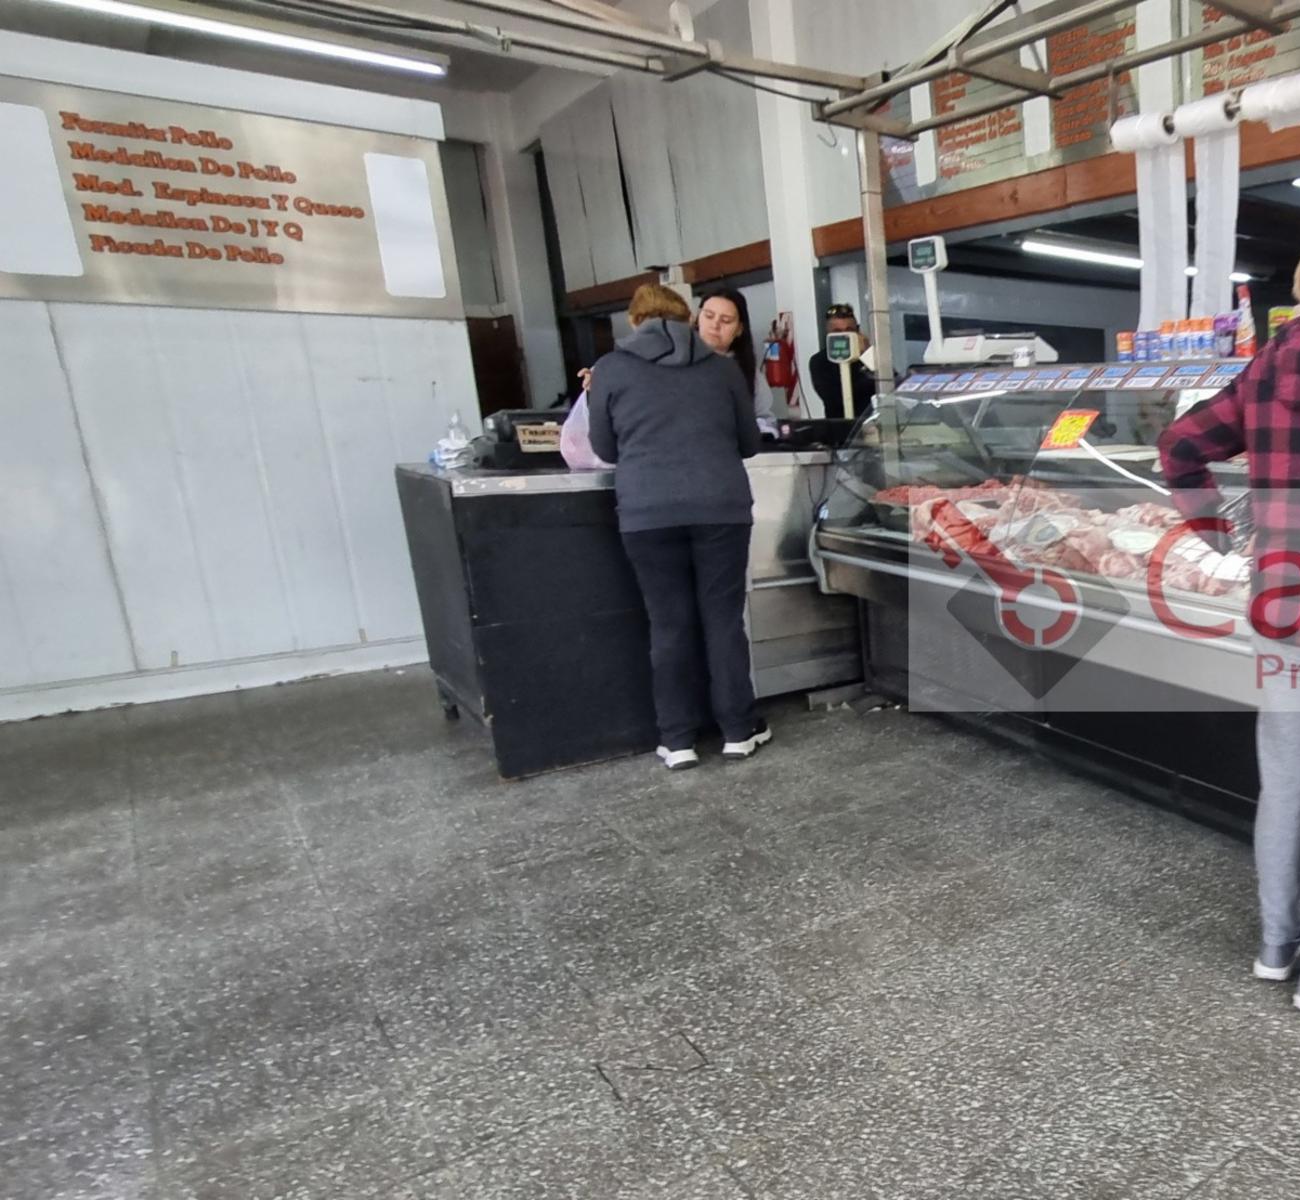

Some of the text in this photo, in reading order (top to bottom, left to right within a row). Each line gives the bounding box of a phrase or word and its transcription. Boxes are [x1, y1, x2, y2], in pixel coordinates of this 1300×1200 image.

[168, 126, 233, 150] Pollo
[67, 140, 298, 185] Medallon De Pollo
[72, 172, 366, 220] Med. Espinaca Y Queso
[81, 203, 210, 233] Medallon
[209, 214, 247, 235] De
[260, 219, 280, 238] Y
[281, 221, 305, 242] Q
[88, 234, 286, 266] Picada De Pollo
